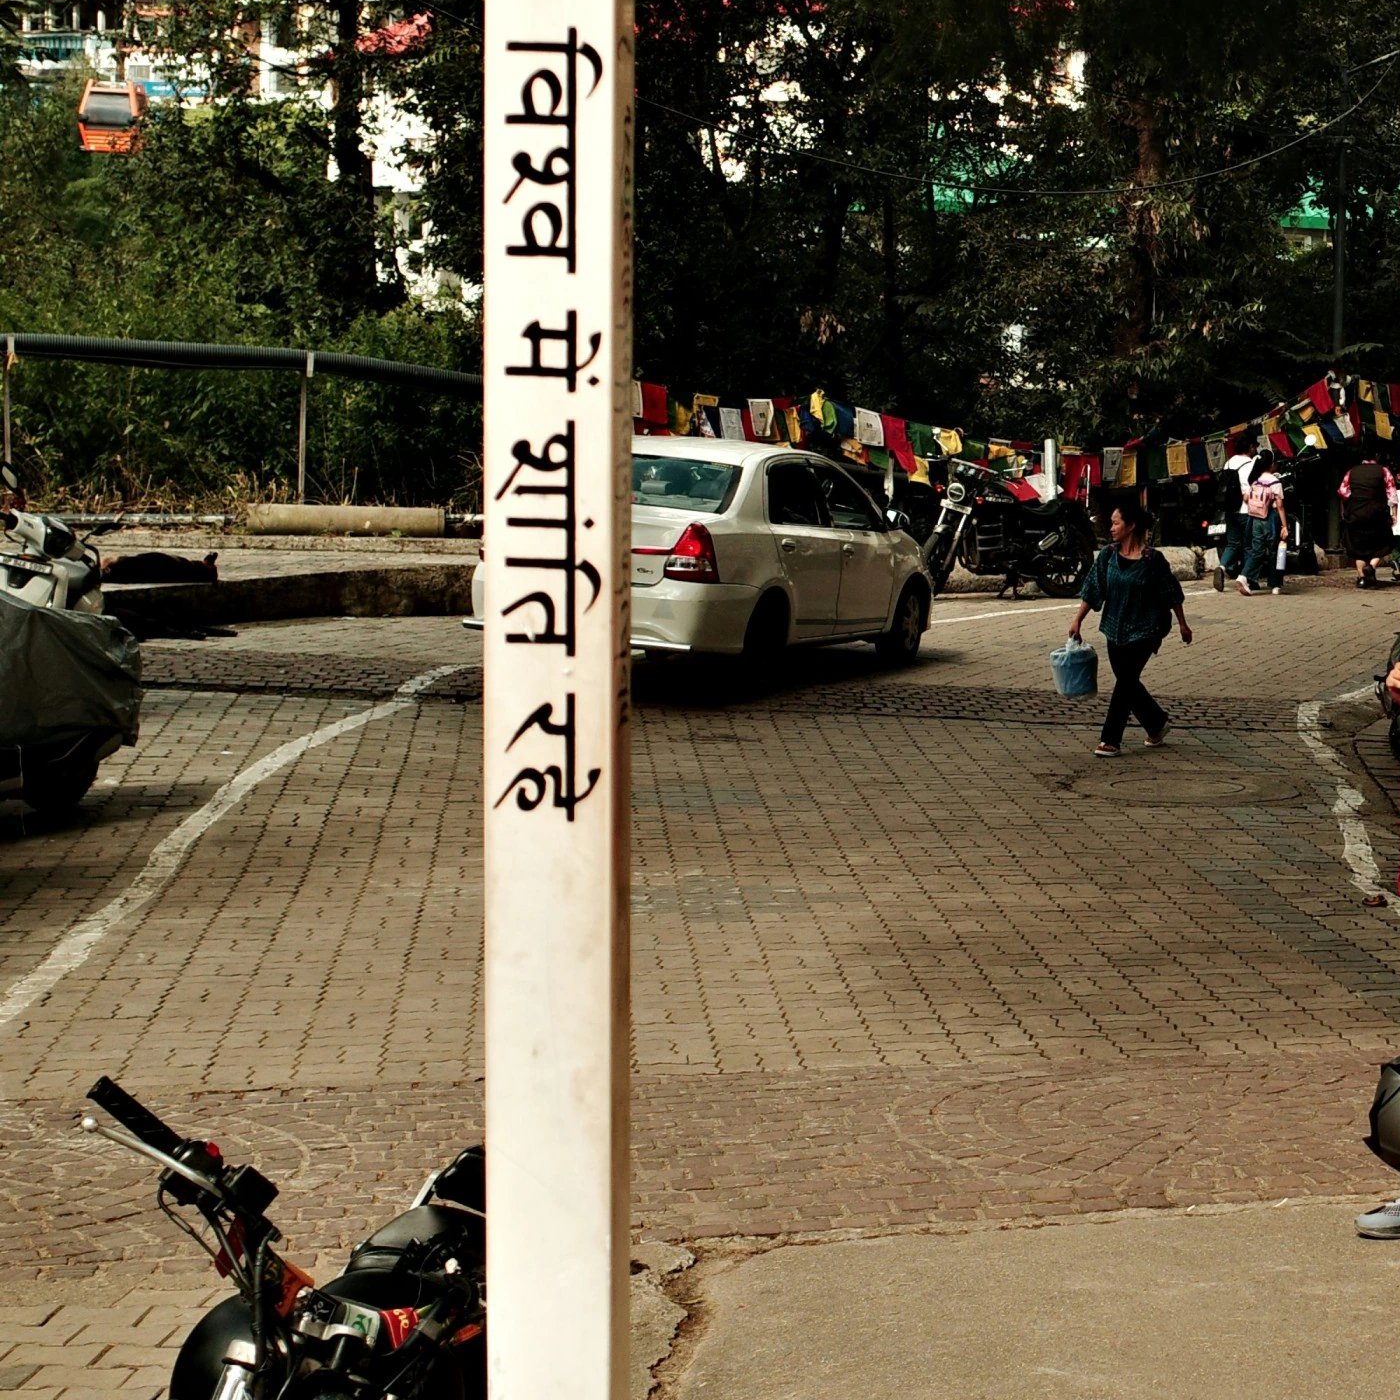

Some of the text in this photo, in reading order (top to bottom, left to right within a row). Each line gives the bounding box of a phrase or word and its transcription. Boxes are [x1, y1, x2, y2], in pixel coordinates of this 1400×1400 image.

[494, 27, 603, 823] विश्व में शांति रहे
